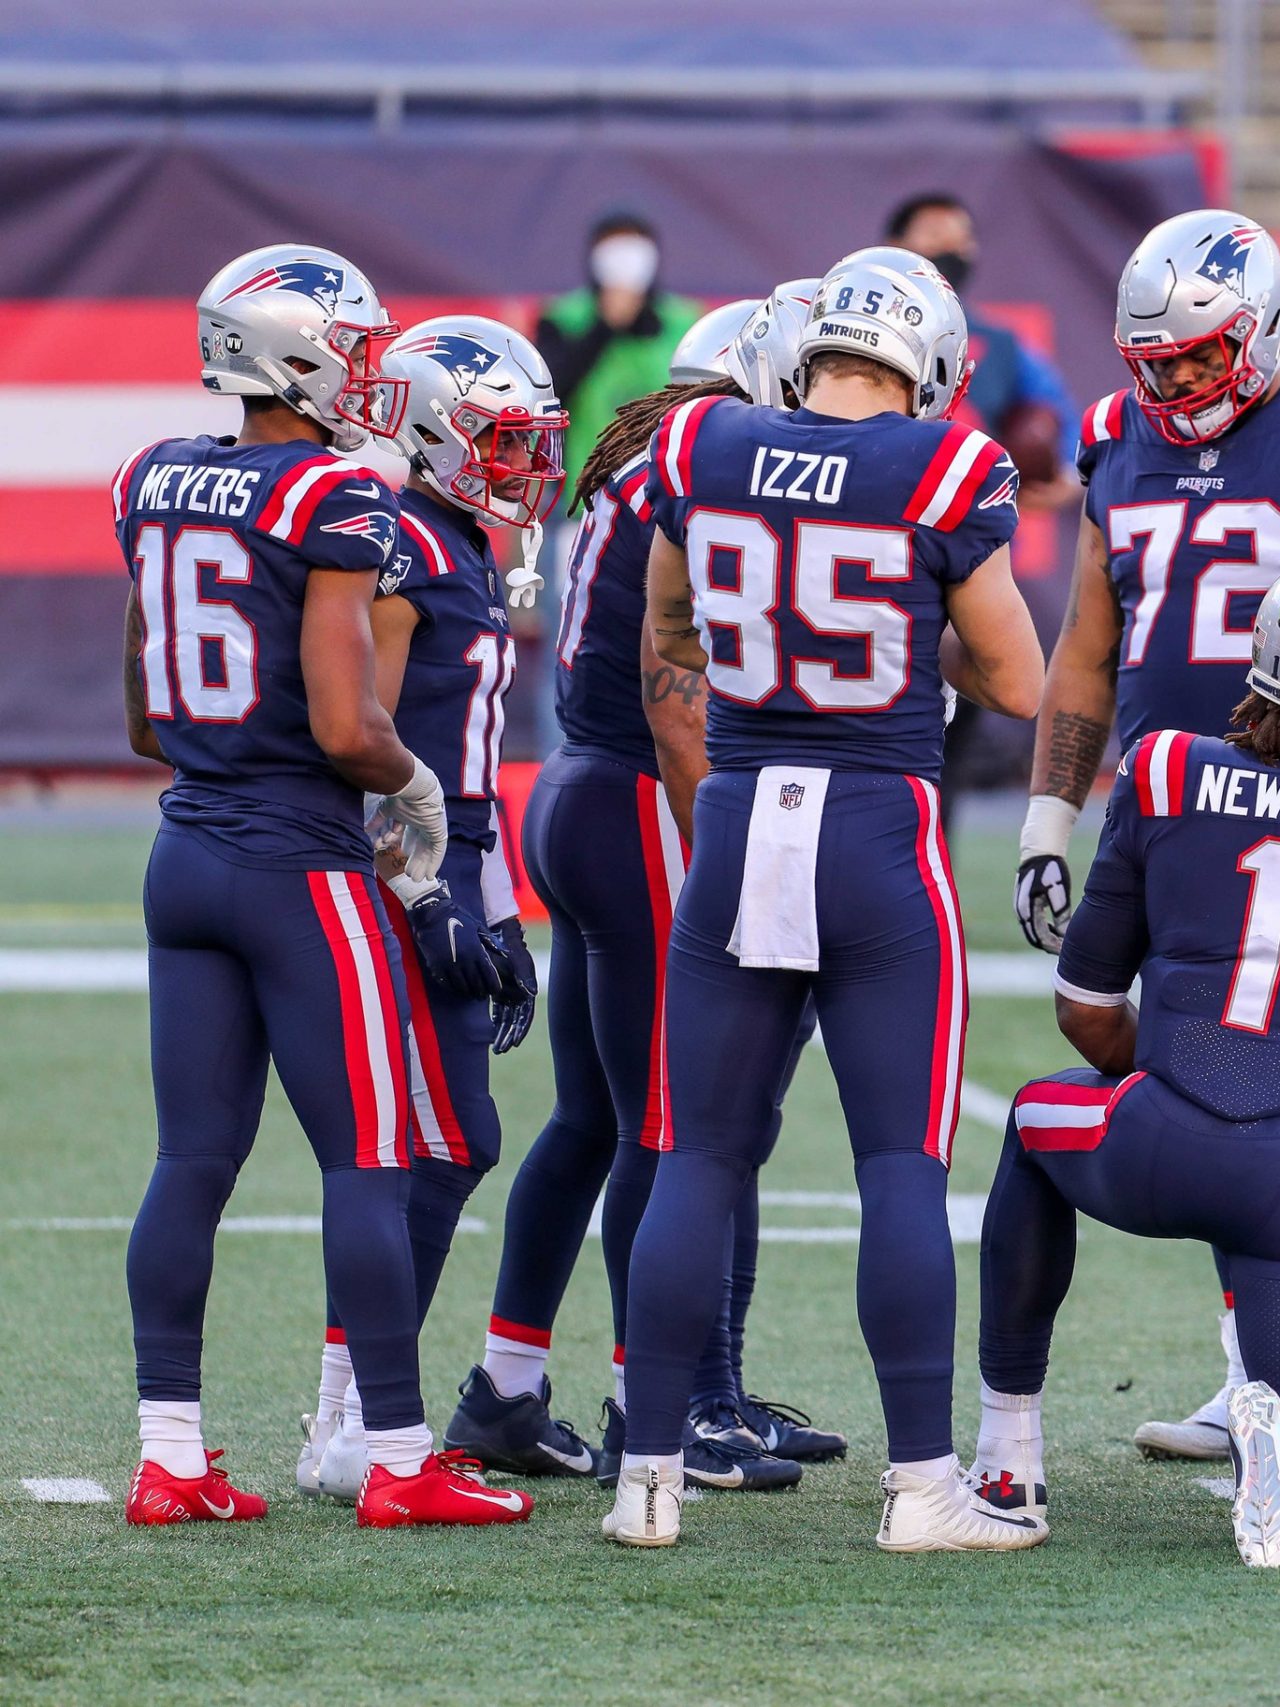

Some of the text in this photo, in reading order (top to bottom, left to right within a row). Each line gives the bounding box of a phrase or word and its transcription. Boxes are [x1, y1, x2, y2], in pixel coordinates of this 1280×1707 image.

[226, 336, 242, 350] WW
[819, 322, 880, 347] PATRIOTS
[750, 446, 848, 504] IZZO
[1176, 477, 1225, 490] PATRIOTS
[136, 464, 261, 517] MEYERS
[683, 505, 915, 713] 85
[133, 522, 261, 725] 16
[781, 793, 801, 807] NFL
[383, 1500, 410, 1516] VAPOR
